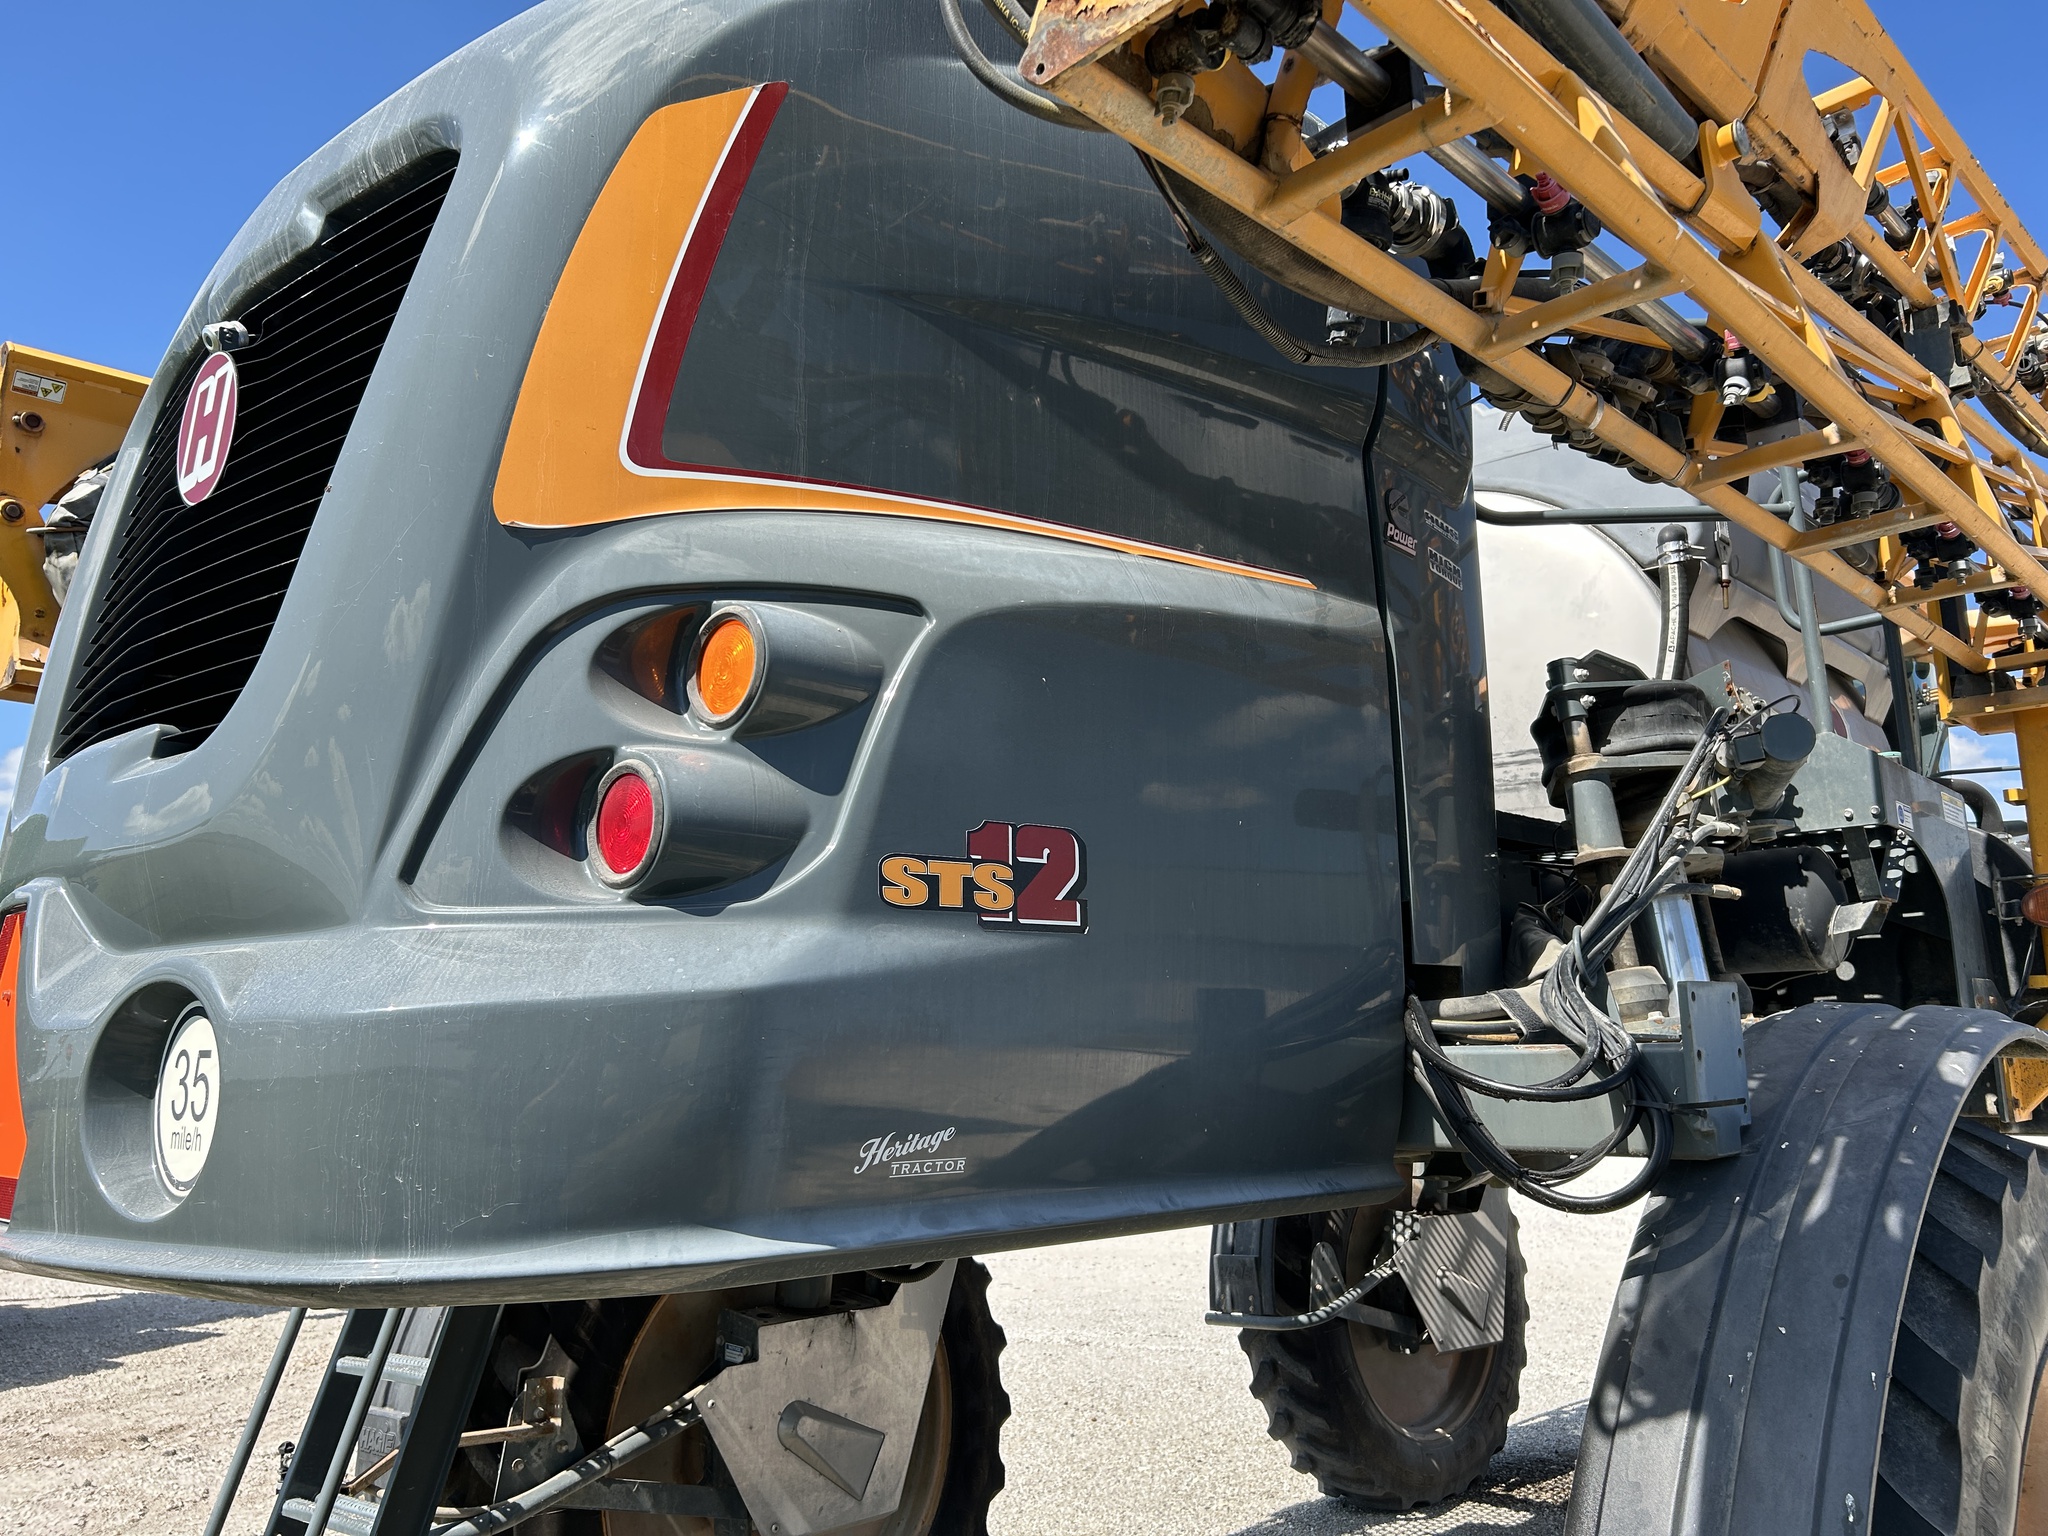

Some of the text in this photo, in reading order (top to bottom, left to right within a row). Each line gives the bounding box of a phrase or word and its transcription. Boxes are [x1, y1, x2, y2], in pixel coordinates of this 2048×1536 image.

[1429, 549, 1462, 579] HIGH
[1429, 561, 1463, 589] TORQUE
[881, 856, 1015, 911] STS
[171, 1048, 212, 1122] 35
[170, 1126, 202, 1152] mile/h
[853, 1126, 957, 1174] Heritage
[890, 1160, 966, 1175] TRACTOR
